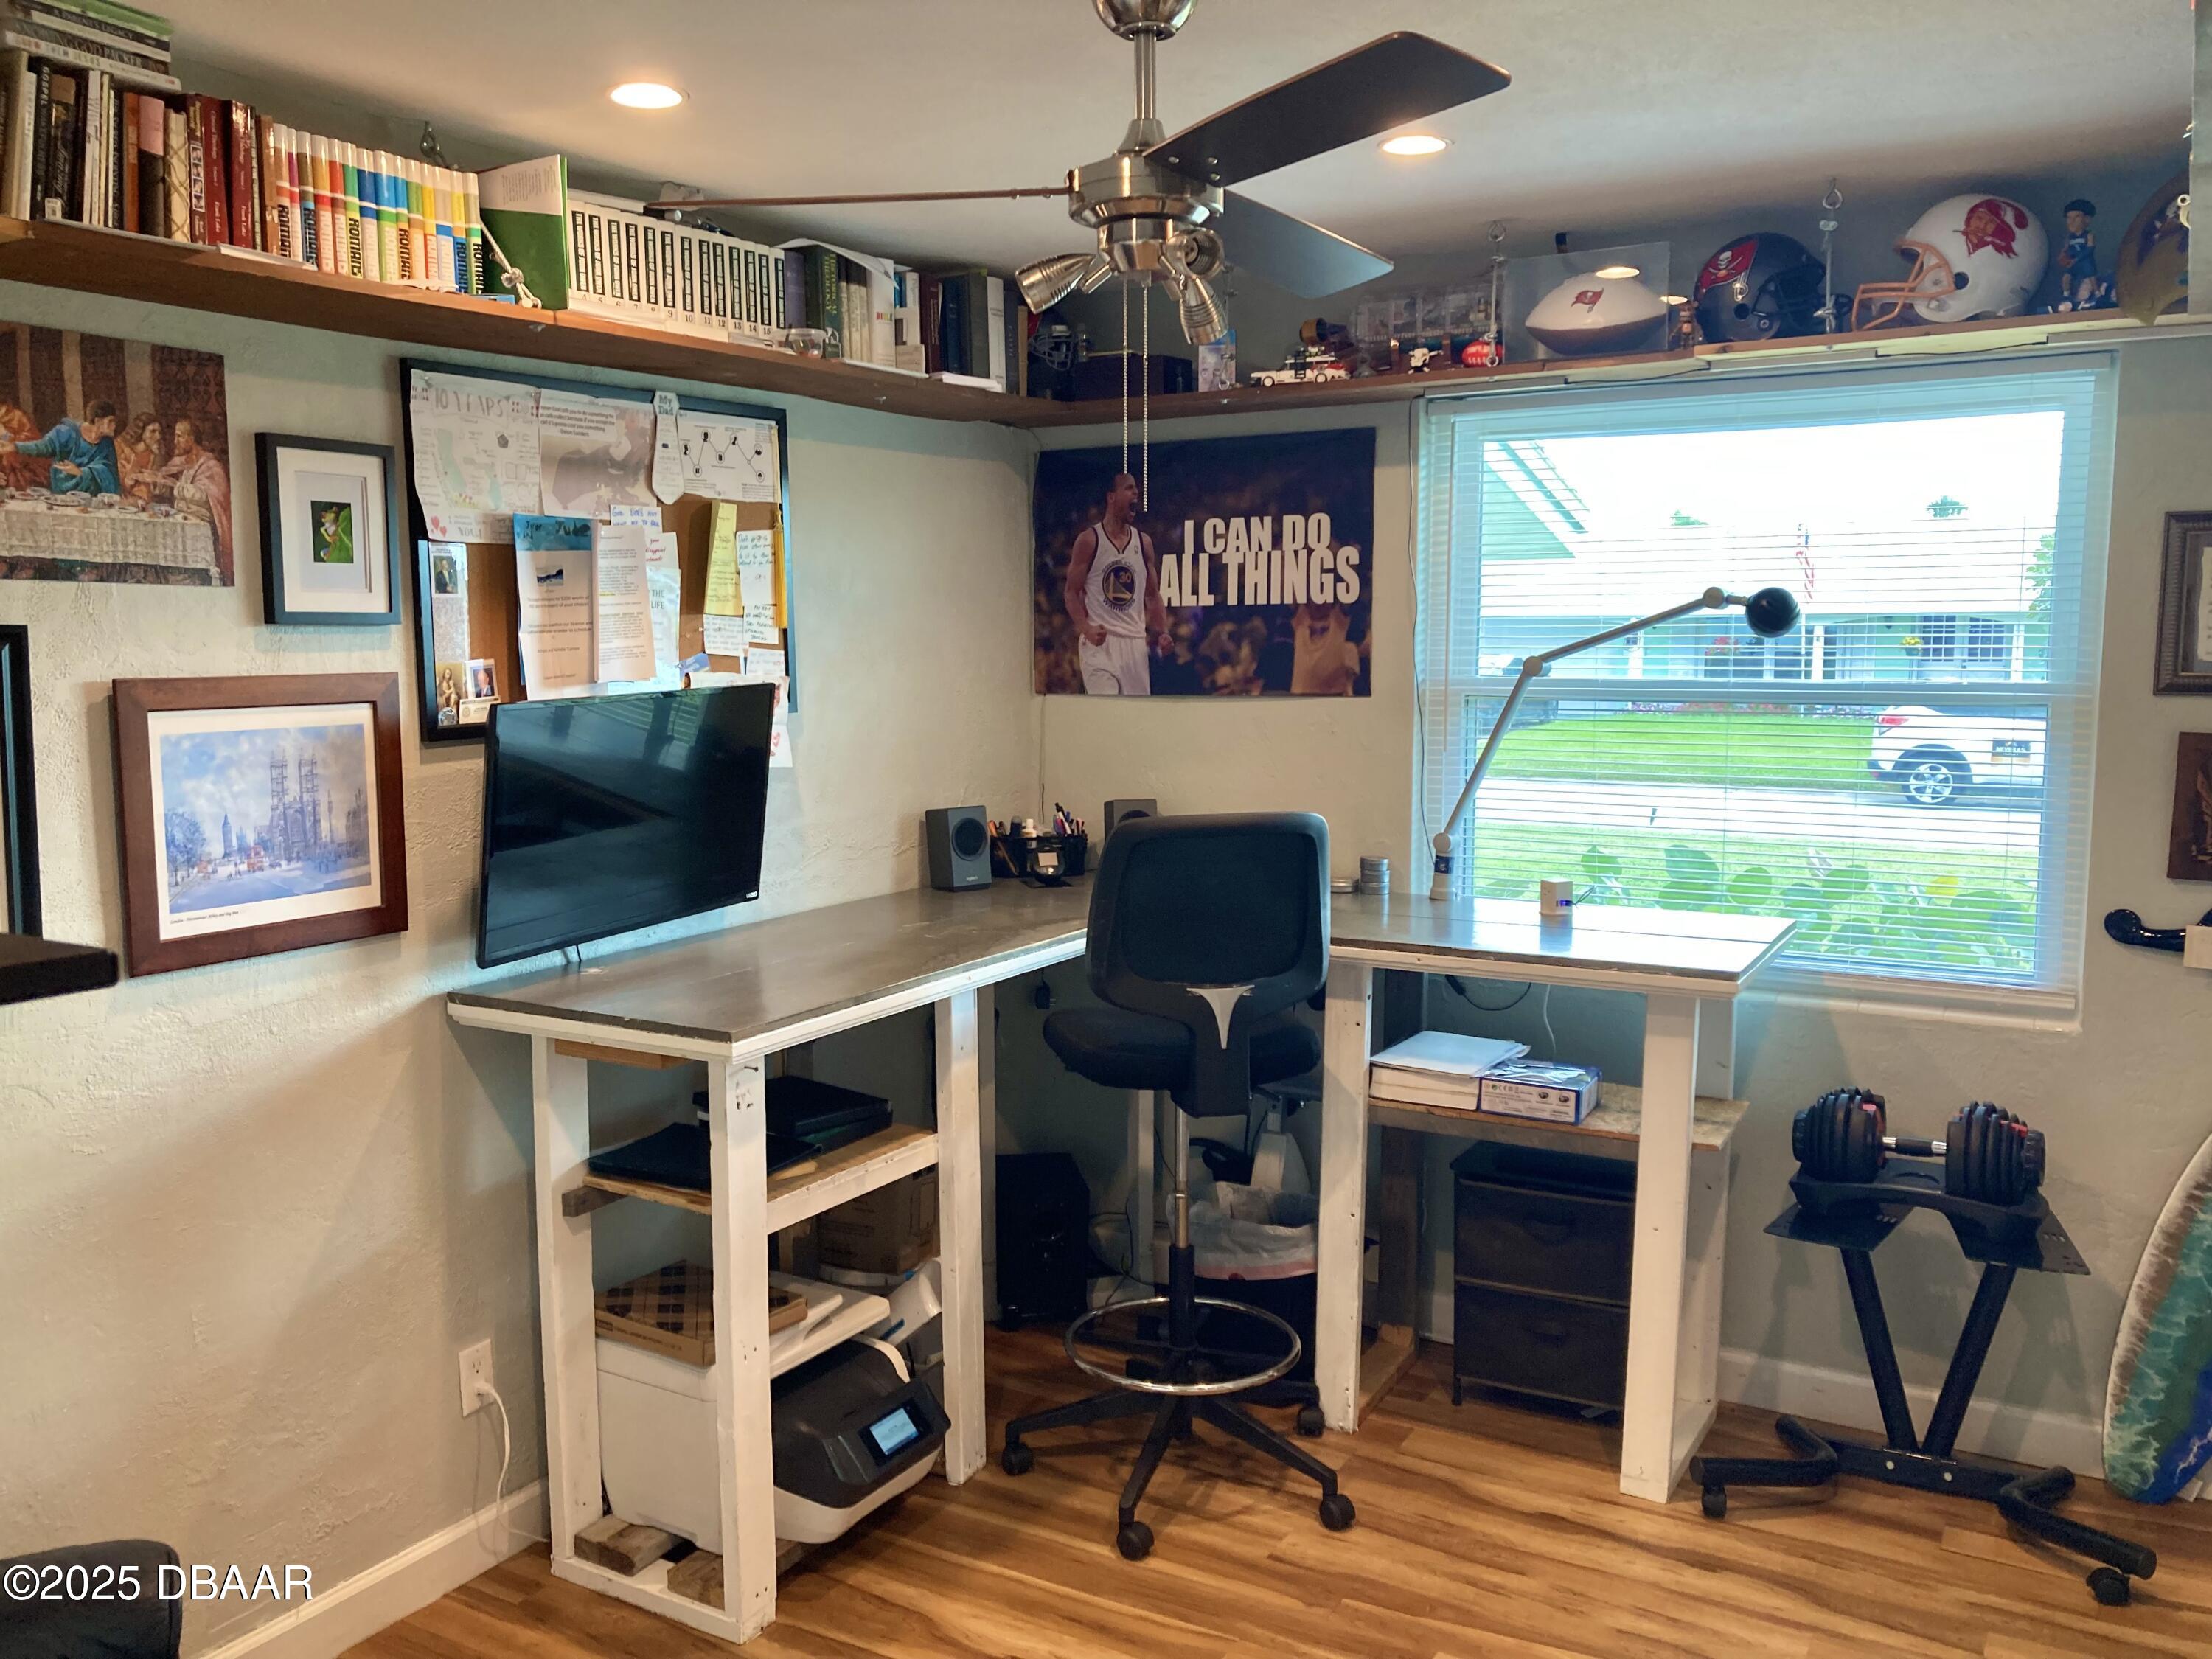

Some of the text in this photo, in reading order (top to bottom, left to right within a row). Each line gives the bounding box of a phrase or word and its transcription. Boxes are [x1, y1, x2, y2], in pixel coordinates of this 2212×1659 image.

[103, 46, 142, 69] PACKER
[41, 66, 49, 105] GOSPEL
[278, 204, 291, 258] ROMAN
[349, 218, 362, 276] ROMANS
[704, 316, 711, 324] 11
[718, 319, 726, 327] 12
[734, 321, 742, 330] 13
[749, 324, 757, 333] 14
[763, 327, 771, 335] 15
[658, 394, 672, 406] My
[658, 406, 674, 415] Dad
[1184, 512, 1331, 554] I CAN DO
[1119, 572, 1131, 583] 30
[1159, 546, 1360, 607] ALL THINGS
[651, 601, 665, 609] LIFE
